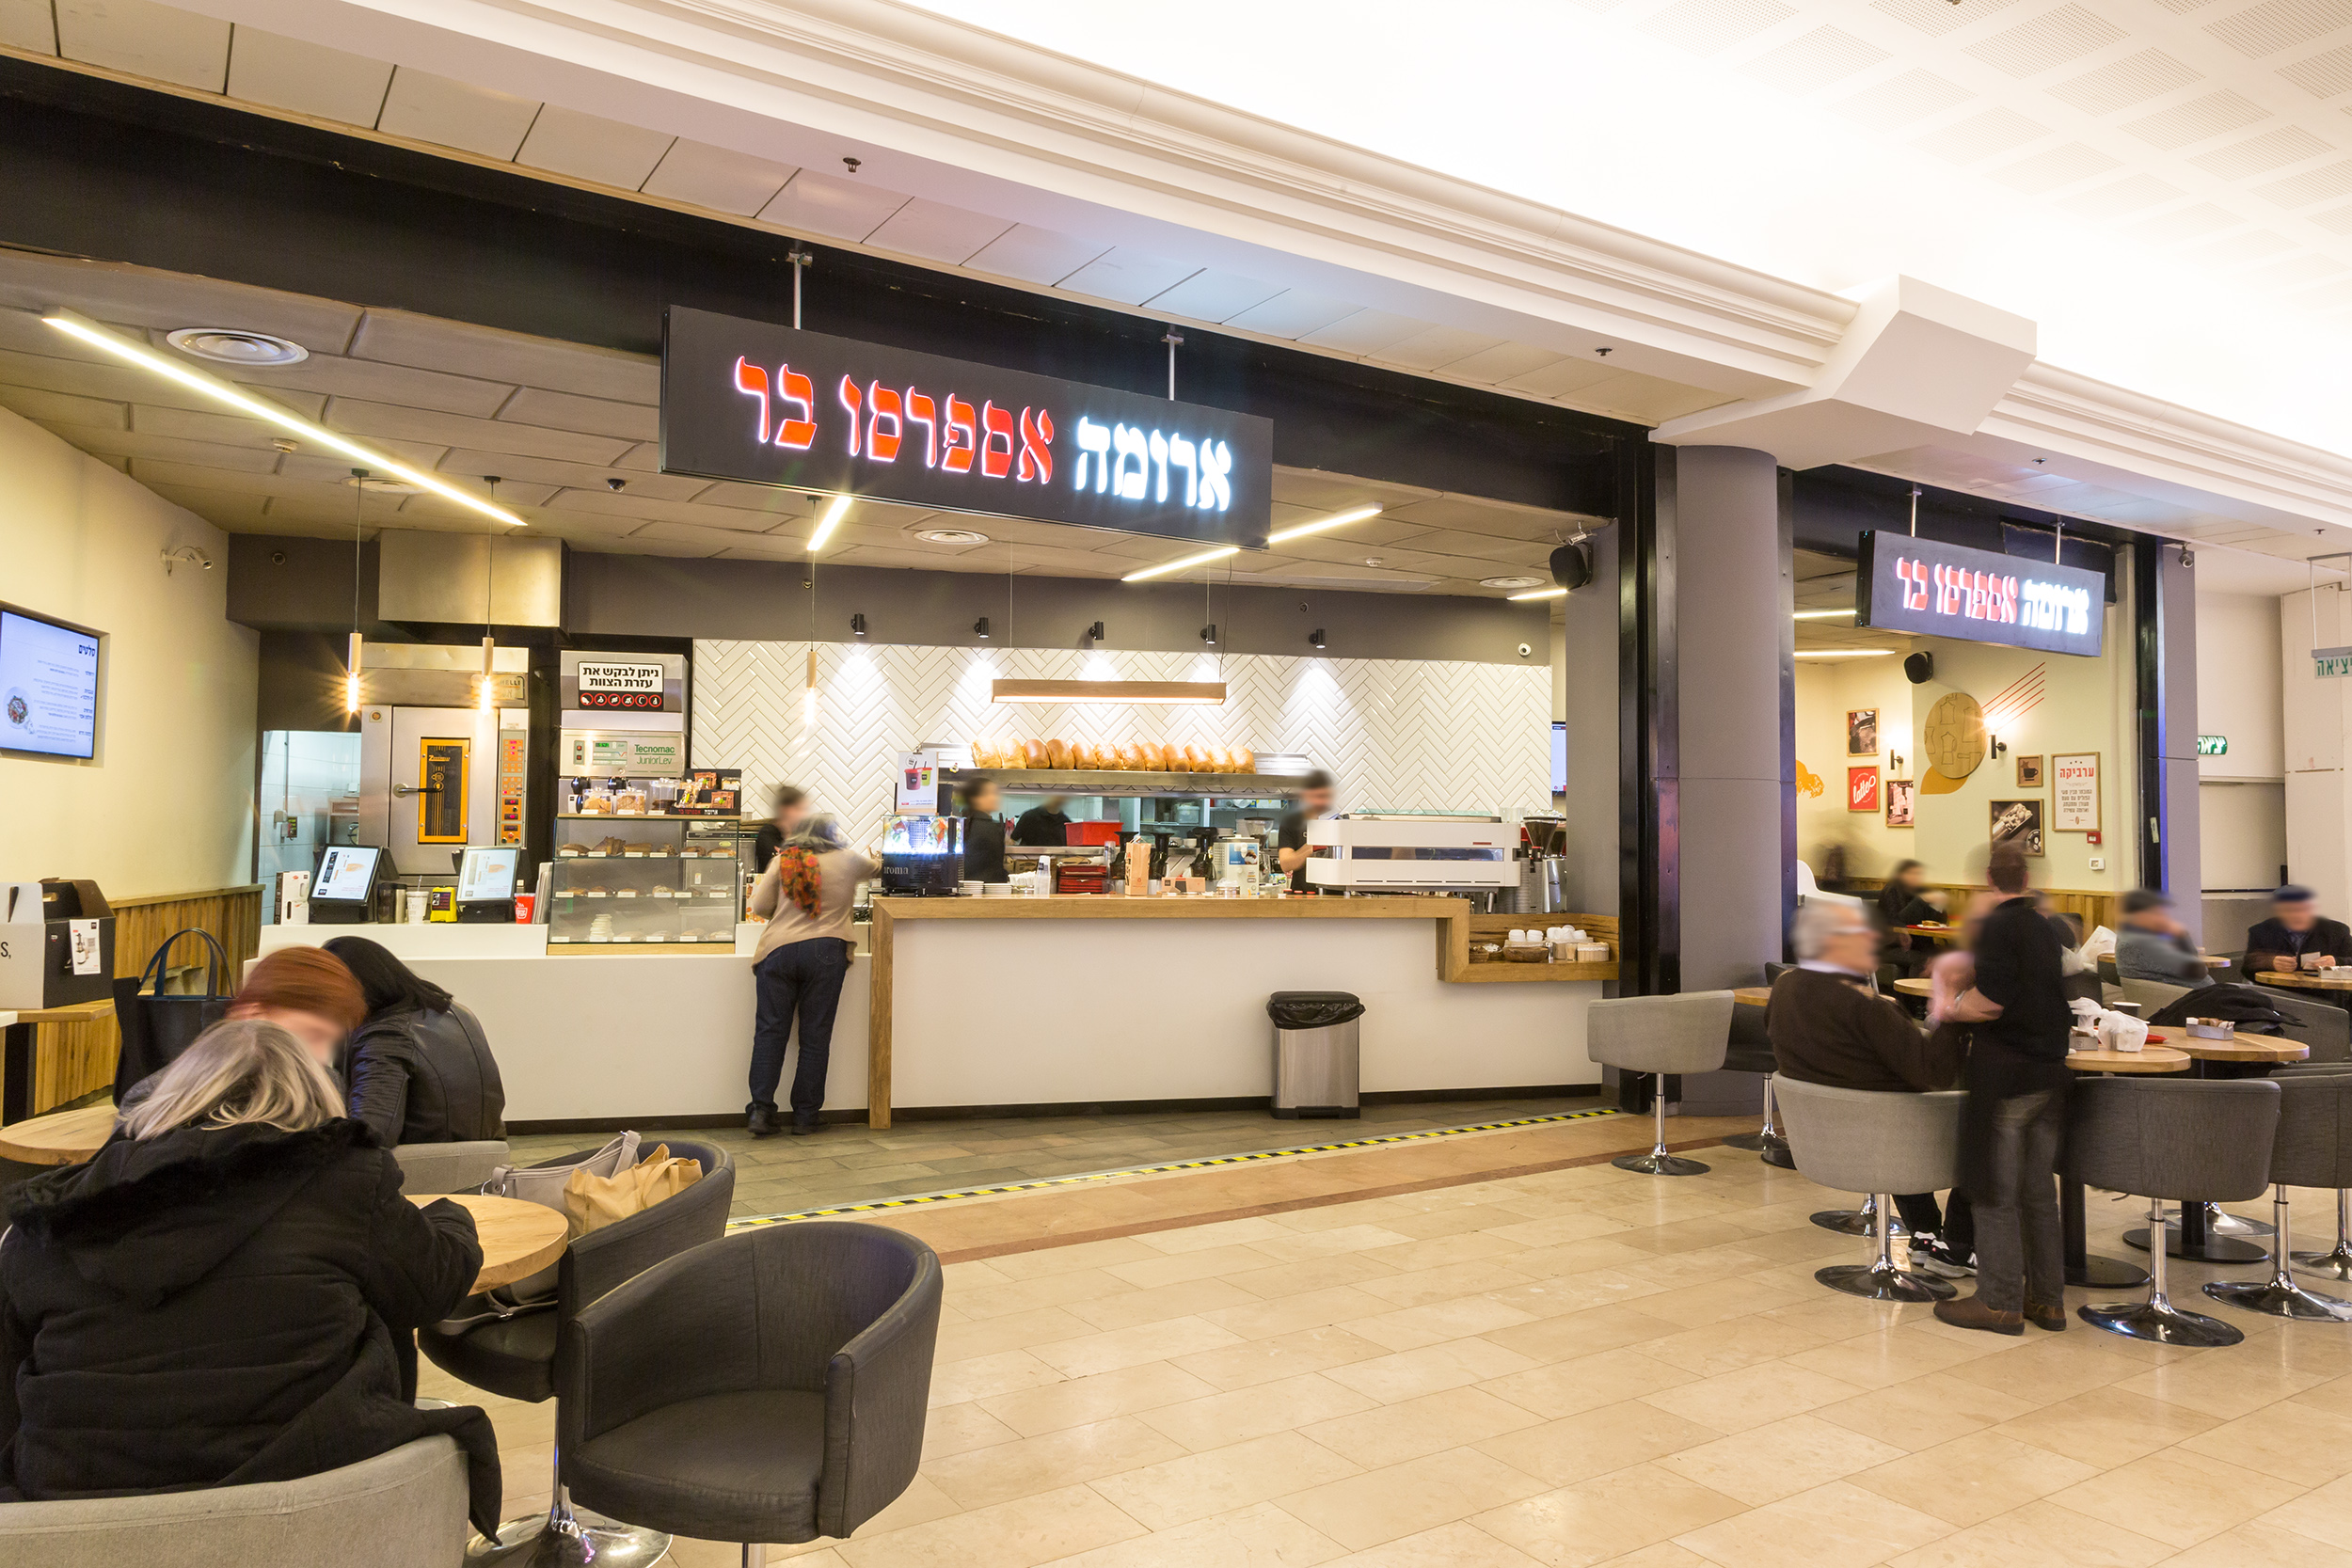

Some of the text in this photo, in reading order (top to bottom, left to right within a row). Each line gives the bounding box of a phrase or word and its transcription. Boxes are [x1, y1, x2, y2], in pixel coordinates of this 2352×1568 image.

[735, 356, 1232, 513] ארומה אספרסו בר
[1896, 556, 2090, 635] ארומה אספרסו בר
[583, 667, 659, 678] ניתן לבקש את
[589, 677, 653, 689] עזרת הצוות
[634, 744, 675, 753] Tecnomac
[2059, 767, 2094, 779] ערביקה
